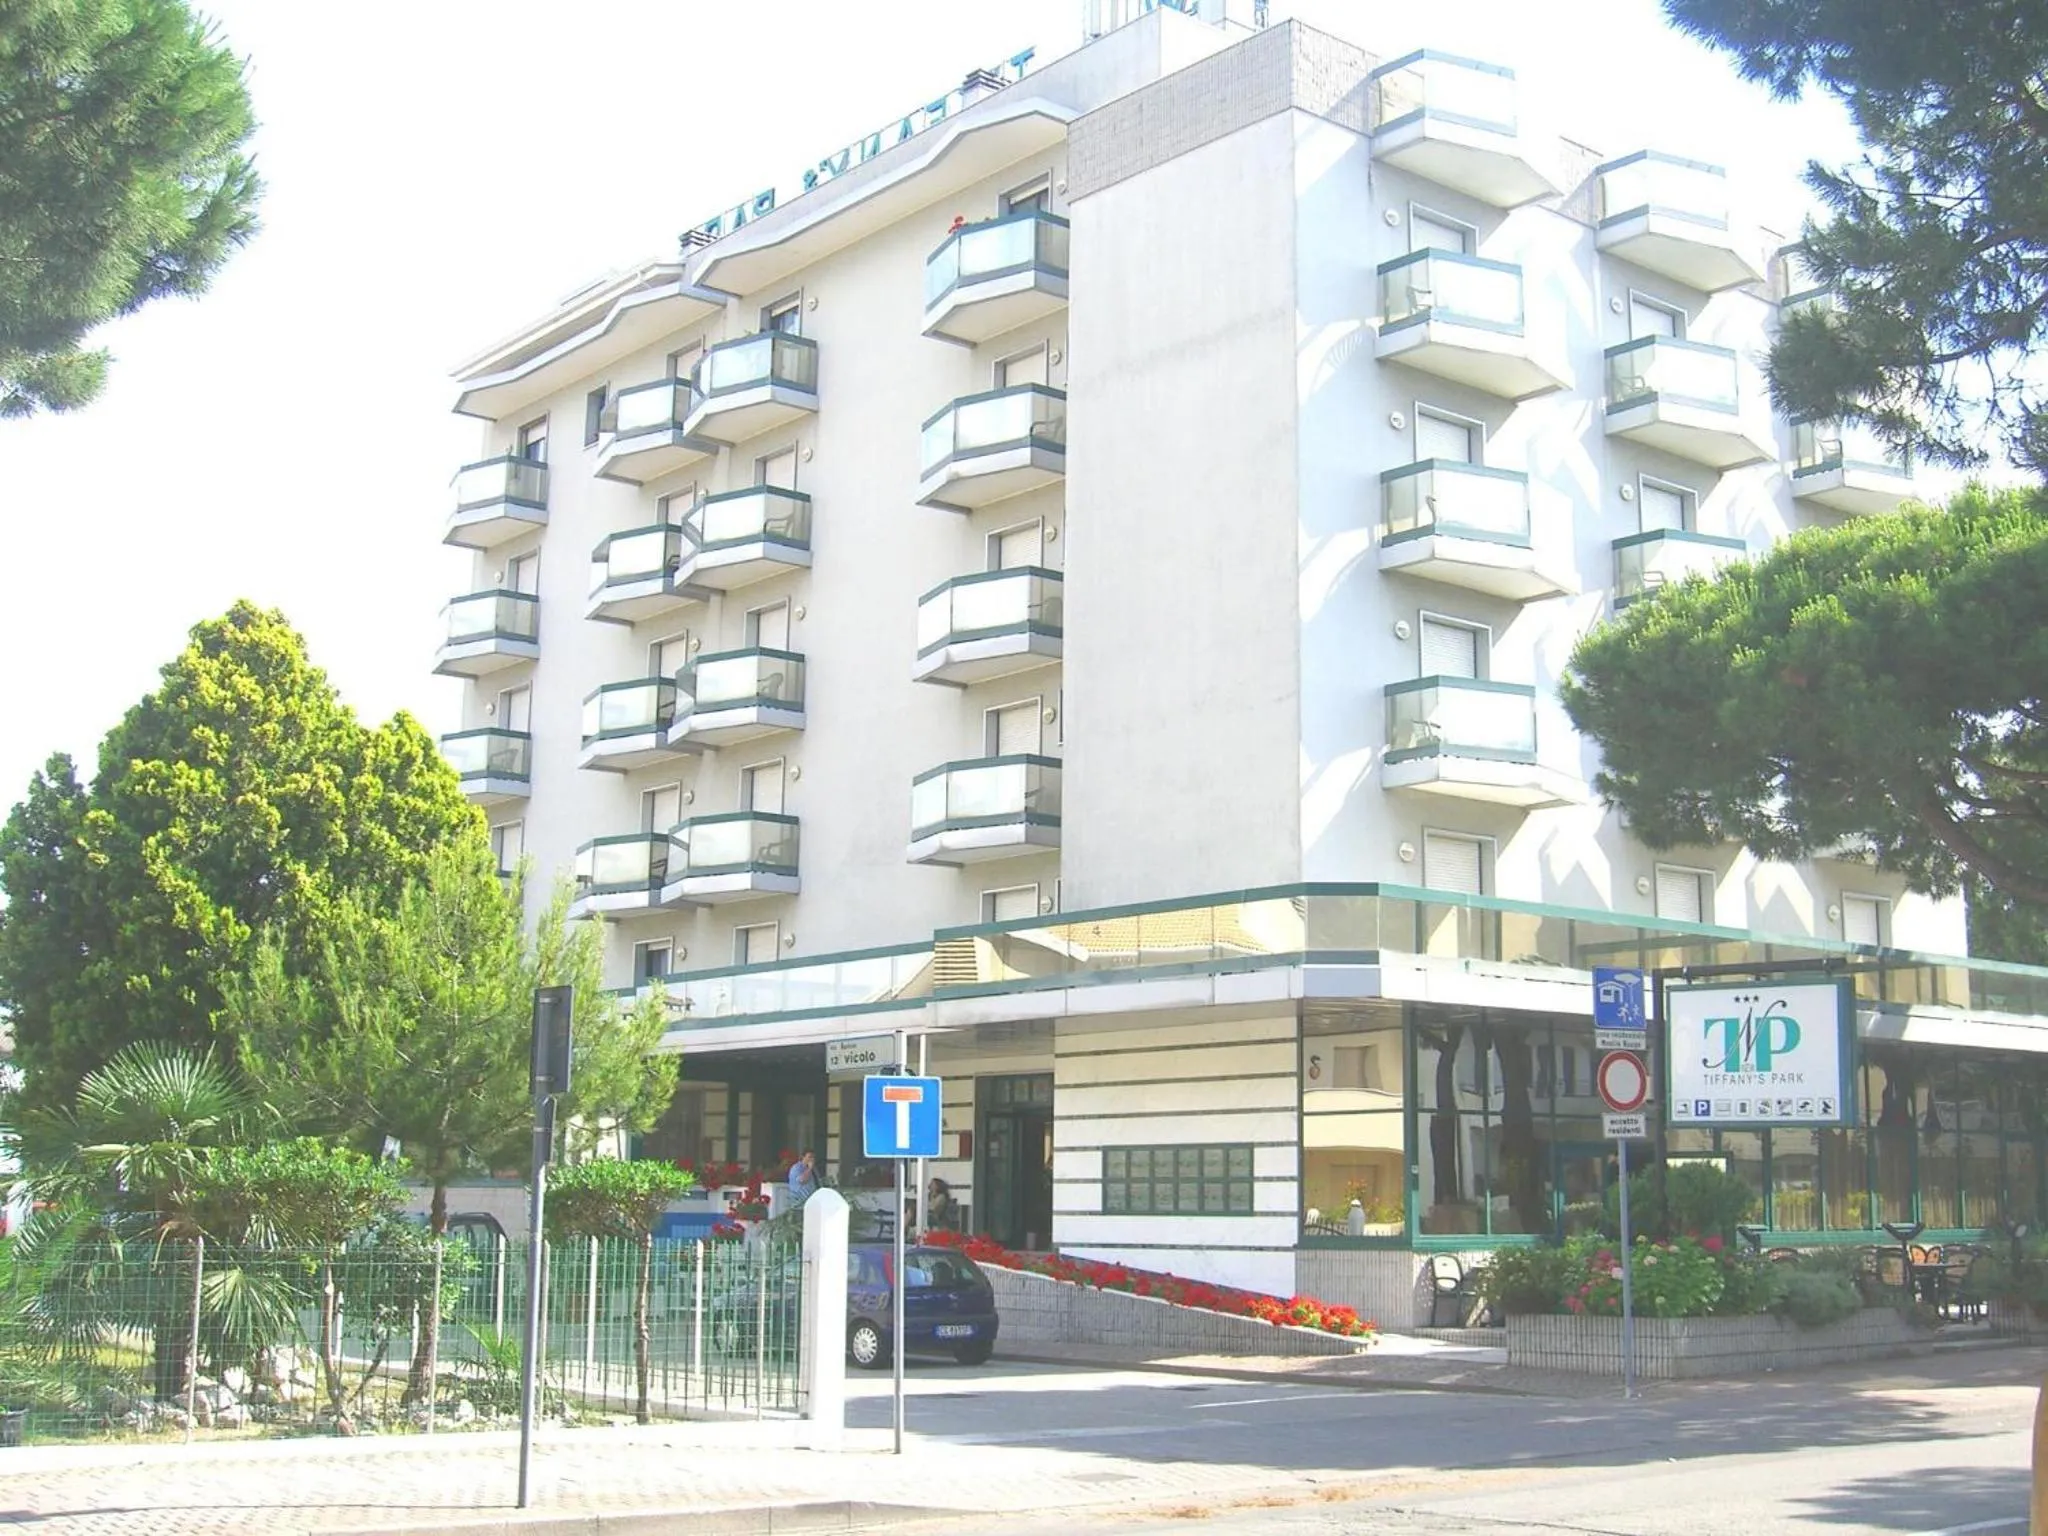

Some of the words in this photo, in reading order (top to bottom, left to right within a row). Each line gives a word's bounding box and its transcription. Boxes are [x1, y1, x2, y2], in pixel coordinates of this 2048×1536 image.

[844, 1050, 876, 1064] vicolo
[1703, 1073, 1766, 1086] TIFFANY'S
[1771, 1072, 1804, 1085] PARK
[1698, 1101, 1708, 1115] P
[1608, 1126, 1641, 1135] residenti
